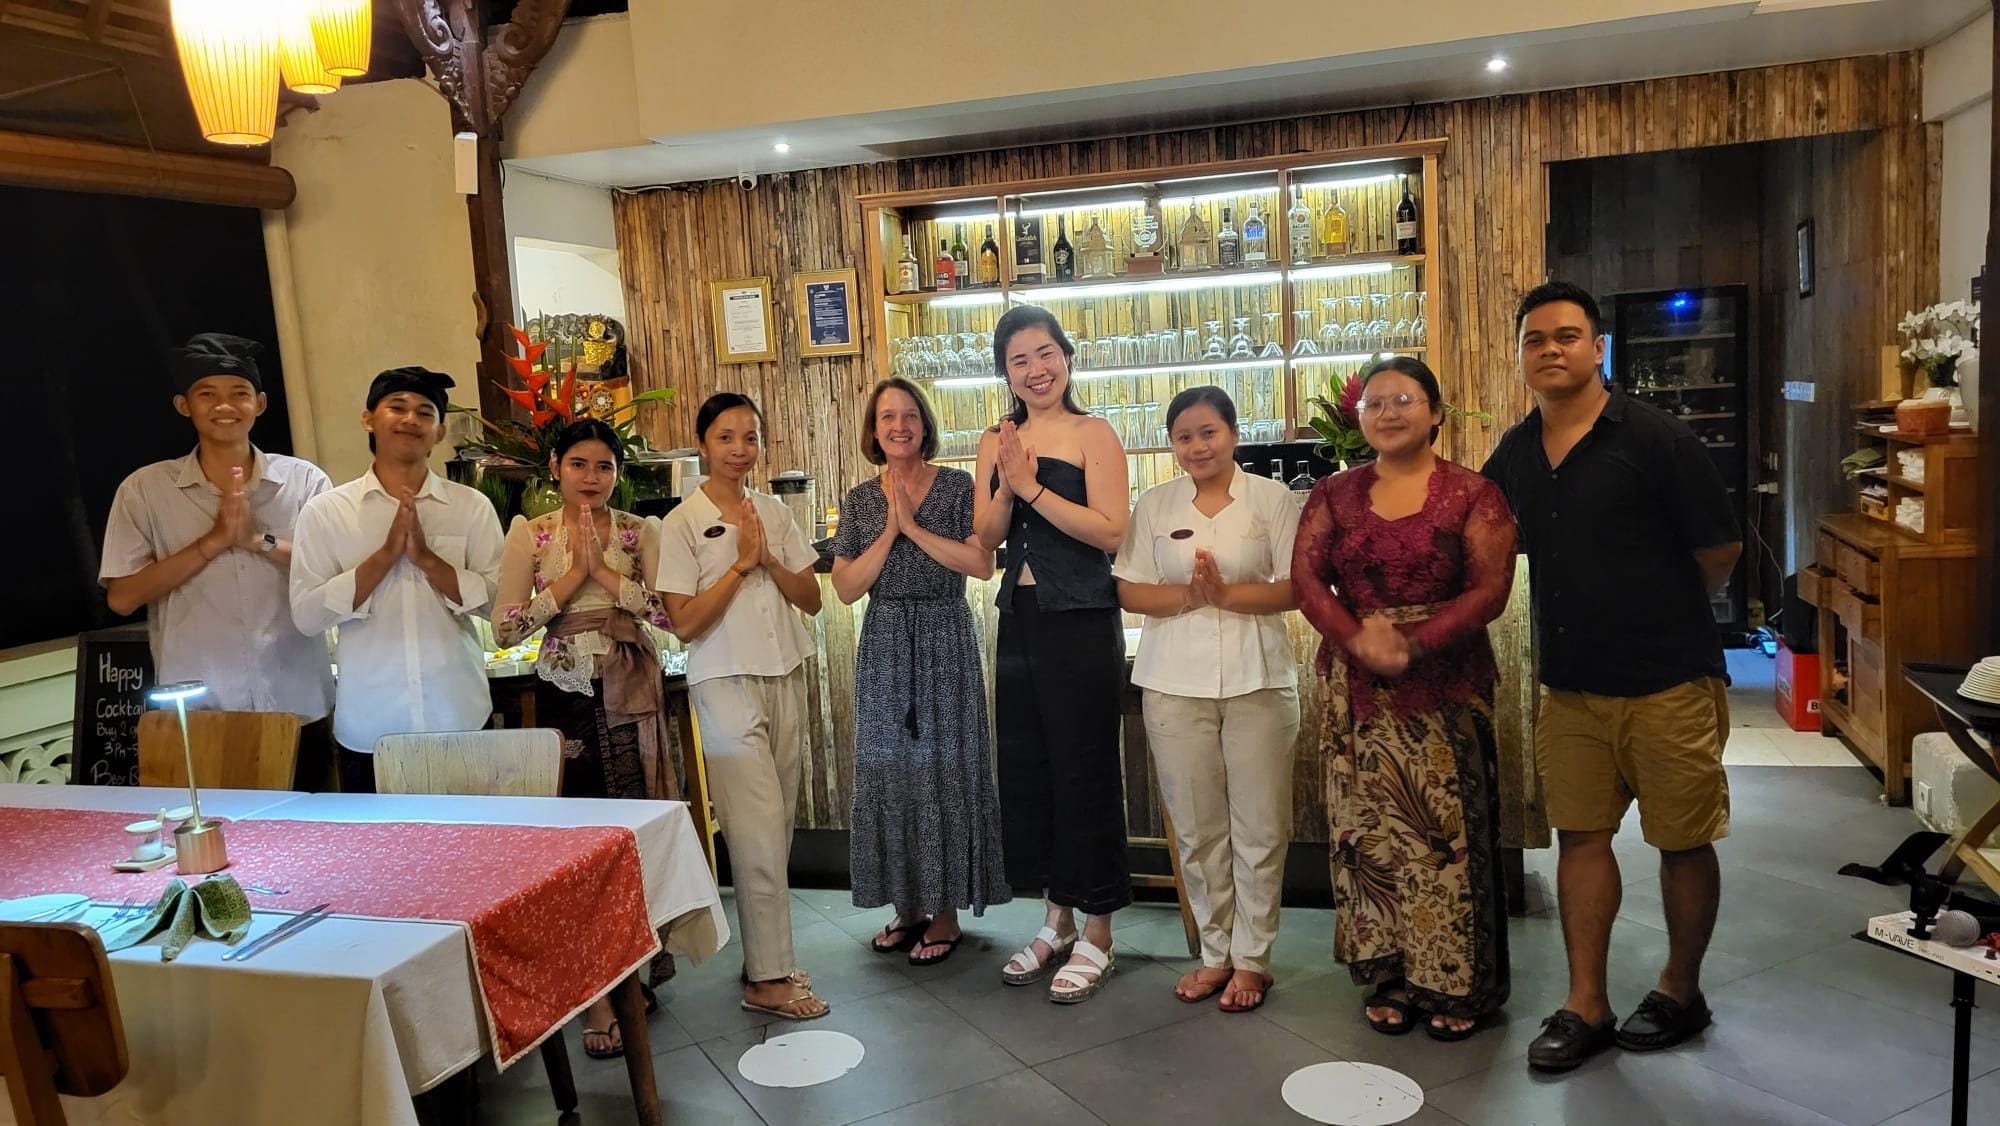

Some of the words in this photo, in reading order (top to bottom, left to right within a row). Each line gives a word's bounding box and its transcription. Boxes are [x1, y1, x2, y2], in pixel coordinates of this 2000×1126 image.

[99, 652, 143, 693] Happy
[96, 722, 117, 741] Buy
[120, 720, 127, 737] 2
[91, 760, 126, 786] Beer
[1874, 926, 1915, 949] M-VAVE
